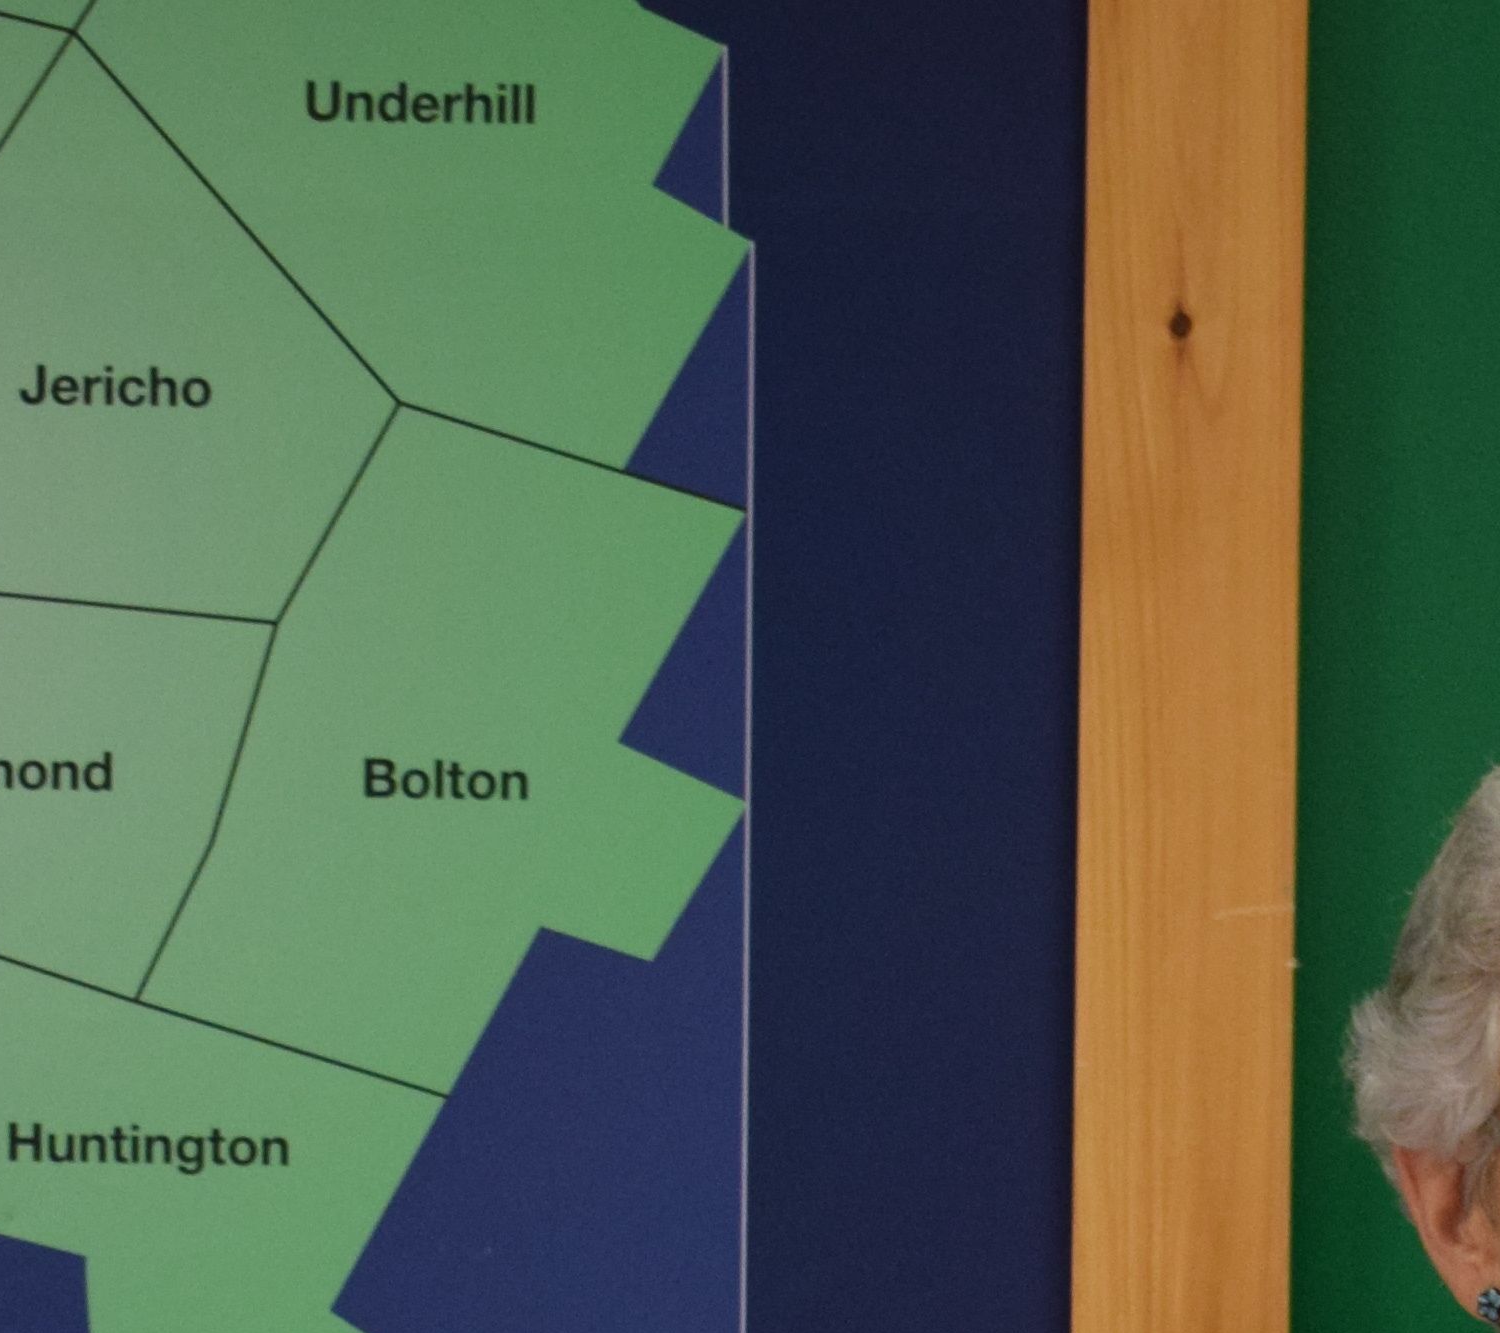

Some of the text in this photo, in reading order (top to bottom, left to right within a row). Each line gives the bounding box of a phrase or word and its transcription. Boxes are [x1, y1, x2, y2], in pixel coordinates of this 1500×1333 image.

[305, 79, 536, 125] Underhill
[18, 363, 213, 410] Jericho
[363, 756, 529, 802] Bolton
[7, 1121, 290, 1176] Huntington
